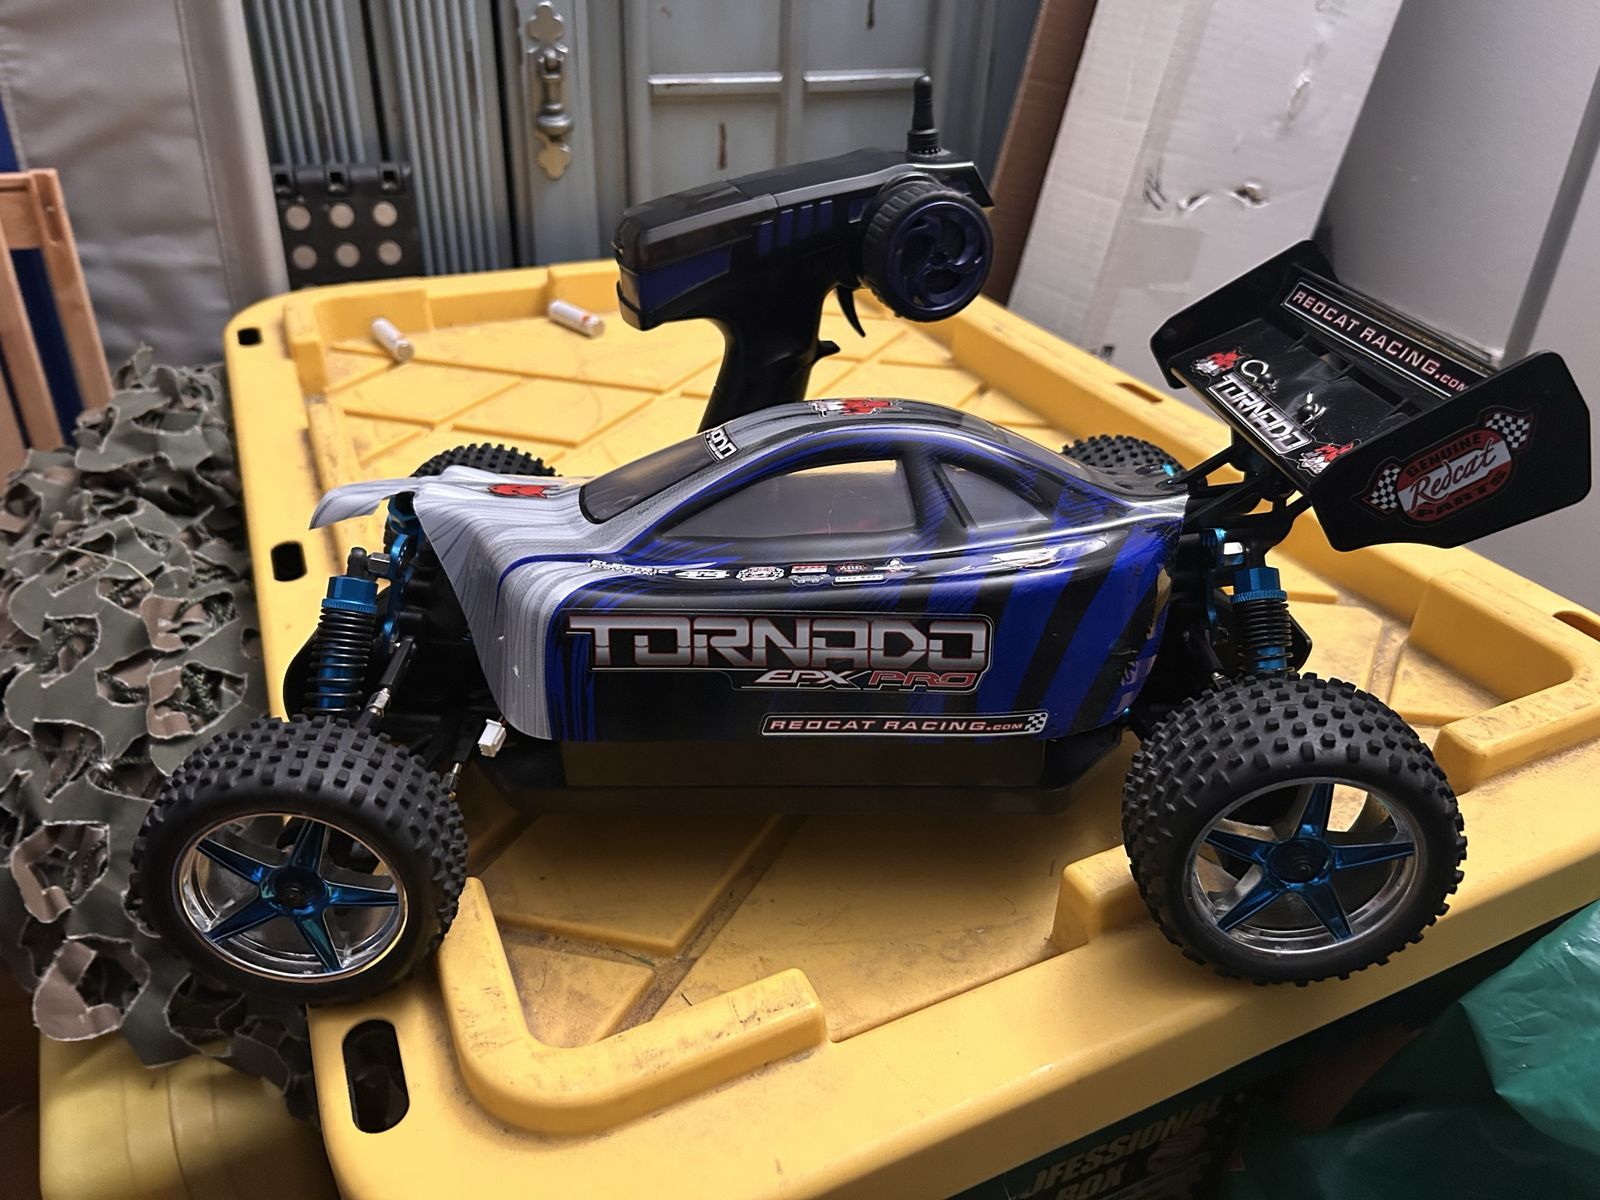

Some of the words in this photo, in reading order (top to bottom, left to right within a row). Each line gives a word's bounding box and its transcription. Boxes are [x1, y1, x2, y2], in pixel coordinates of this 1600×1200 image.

[1292, 290, 1361, 332] REDCAT
[1217, 372, 1309, 452] TORNADO
[1406, 433, 1482, 478] GENUINE
[1410, 438, 1497, 512] Redcat
[568, 615, 988, 669] TORNADO
[755, 670, 871, 688] EPX
[868, 670, 979, 687] PRO
[769, 720, 875, 731] REDCAT
